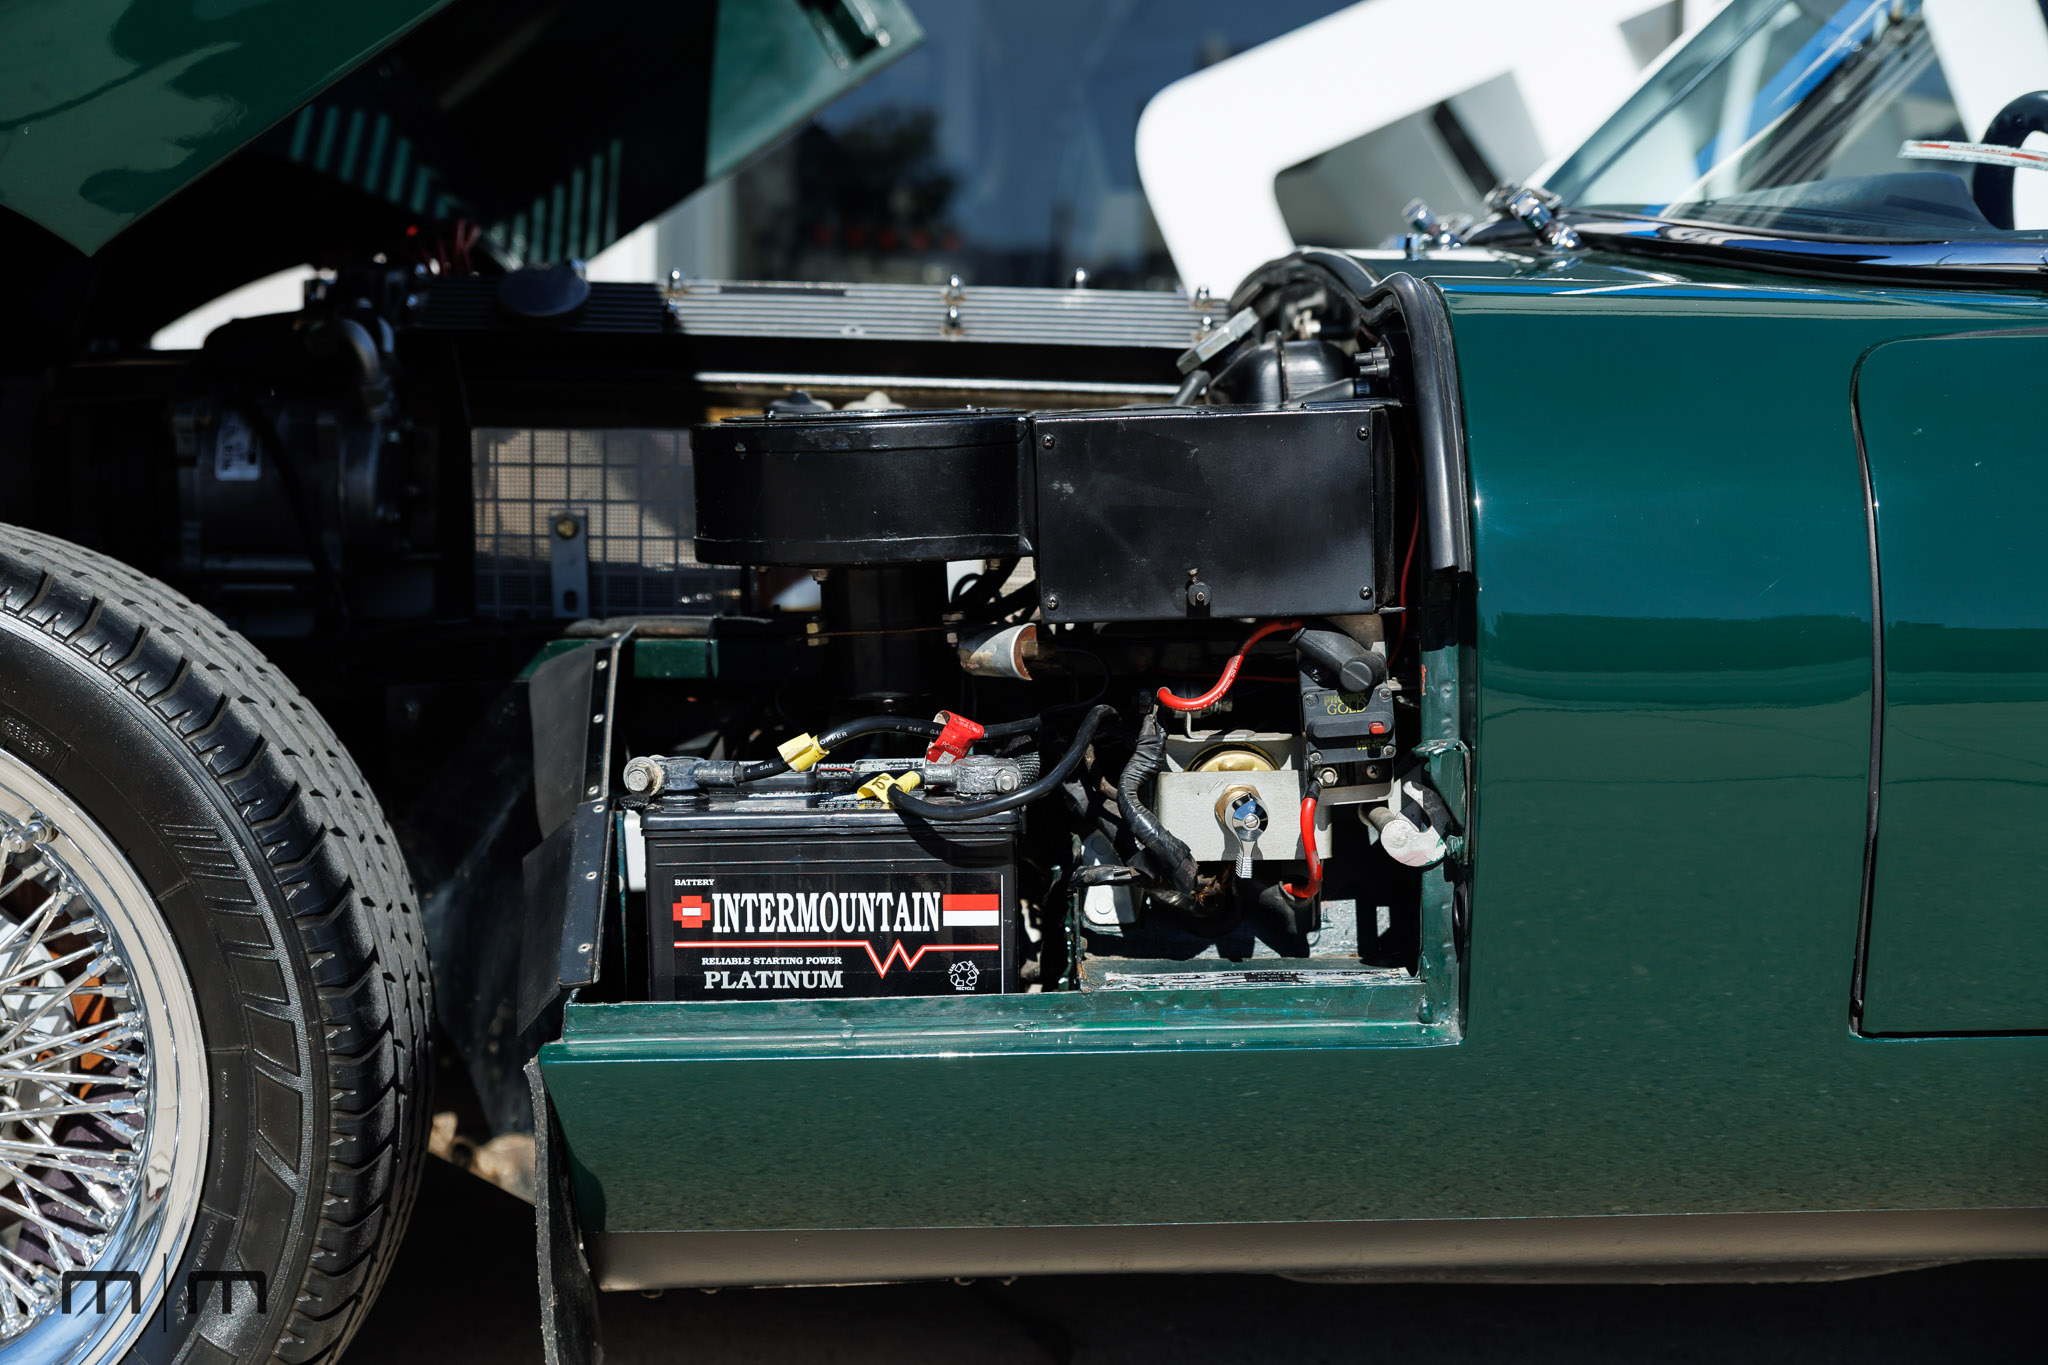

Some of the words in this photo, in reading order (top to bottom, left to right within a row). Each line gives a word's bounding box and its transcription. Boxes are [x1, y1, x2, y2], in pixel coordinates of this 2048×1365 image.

[1327, 701, 1367, 715] GOLD
[819, 731, 848, 745] OPPER
[759, 763, 774, 771] SAE
[712, 892, 941, 933] INTERMOUNTAIN
[701, 957, 751, 965] RELIABLE
[753, 957, 803, 965] STARTING
[805, 956, 842, 965] POWER
[703, 970, 844, 989] PLATINUM
